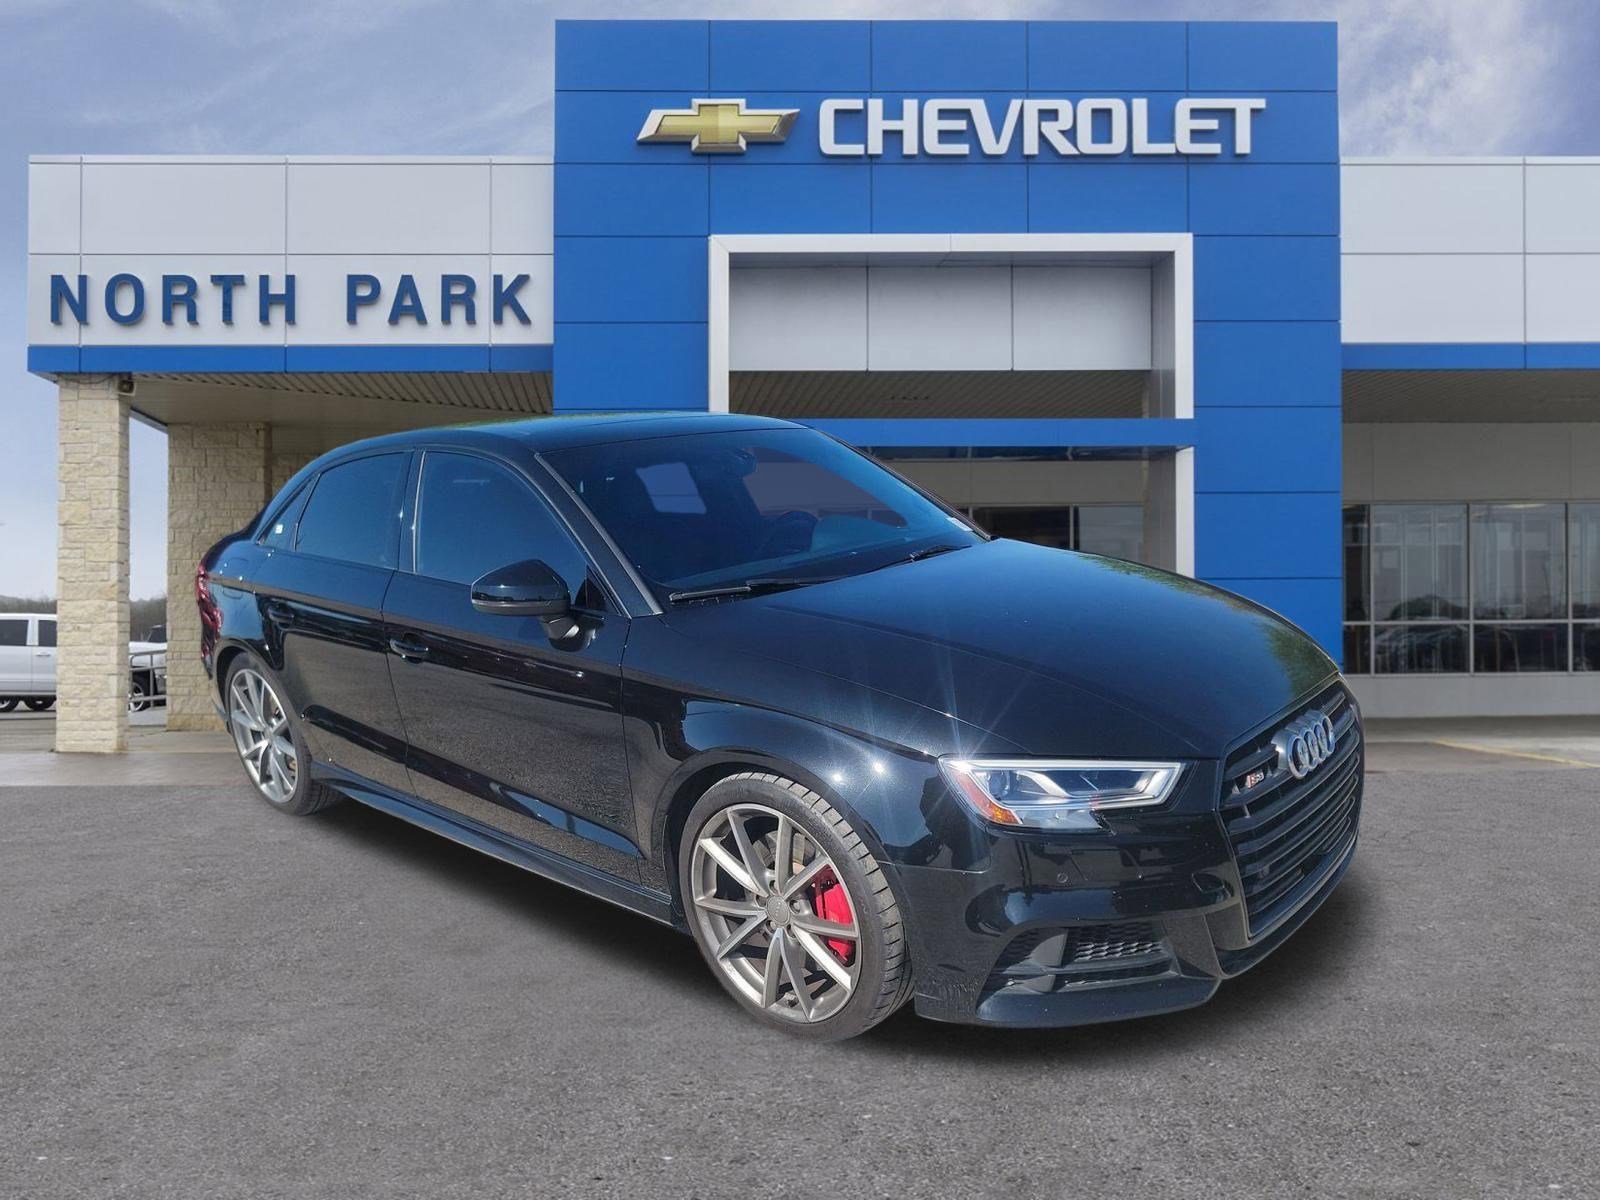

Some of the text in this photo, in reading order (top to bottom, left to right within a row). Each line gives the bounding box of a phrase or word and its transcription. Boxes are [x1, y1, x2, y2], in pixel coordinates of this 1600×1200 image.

[818, 98, 1267, 157] CHEVROLET
[50, 273, 533, 326] NORTH PARK
